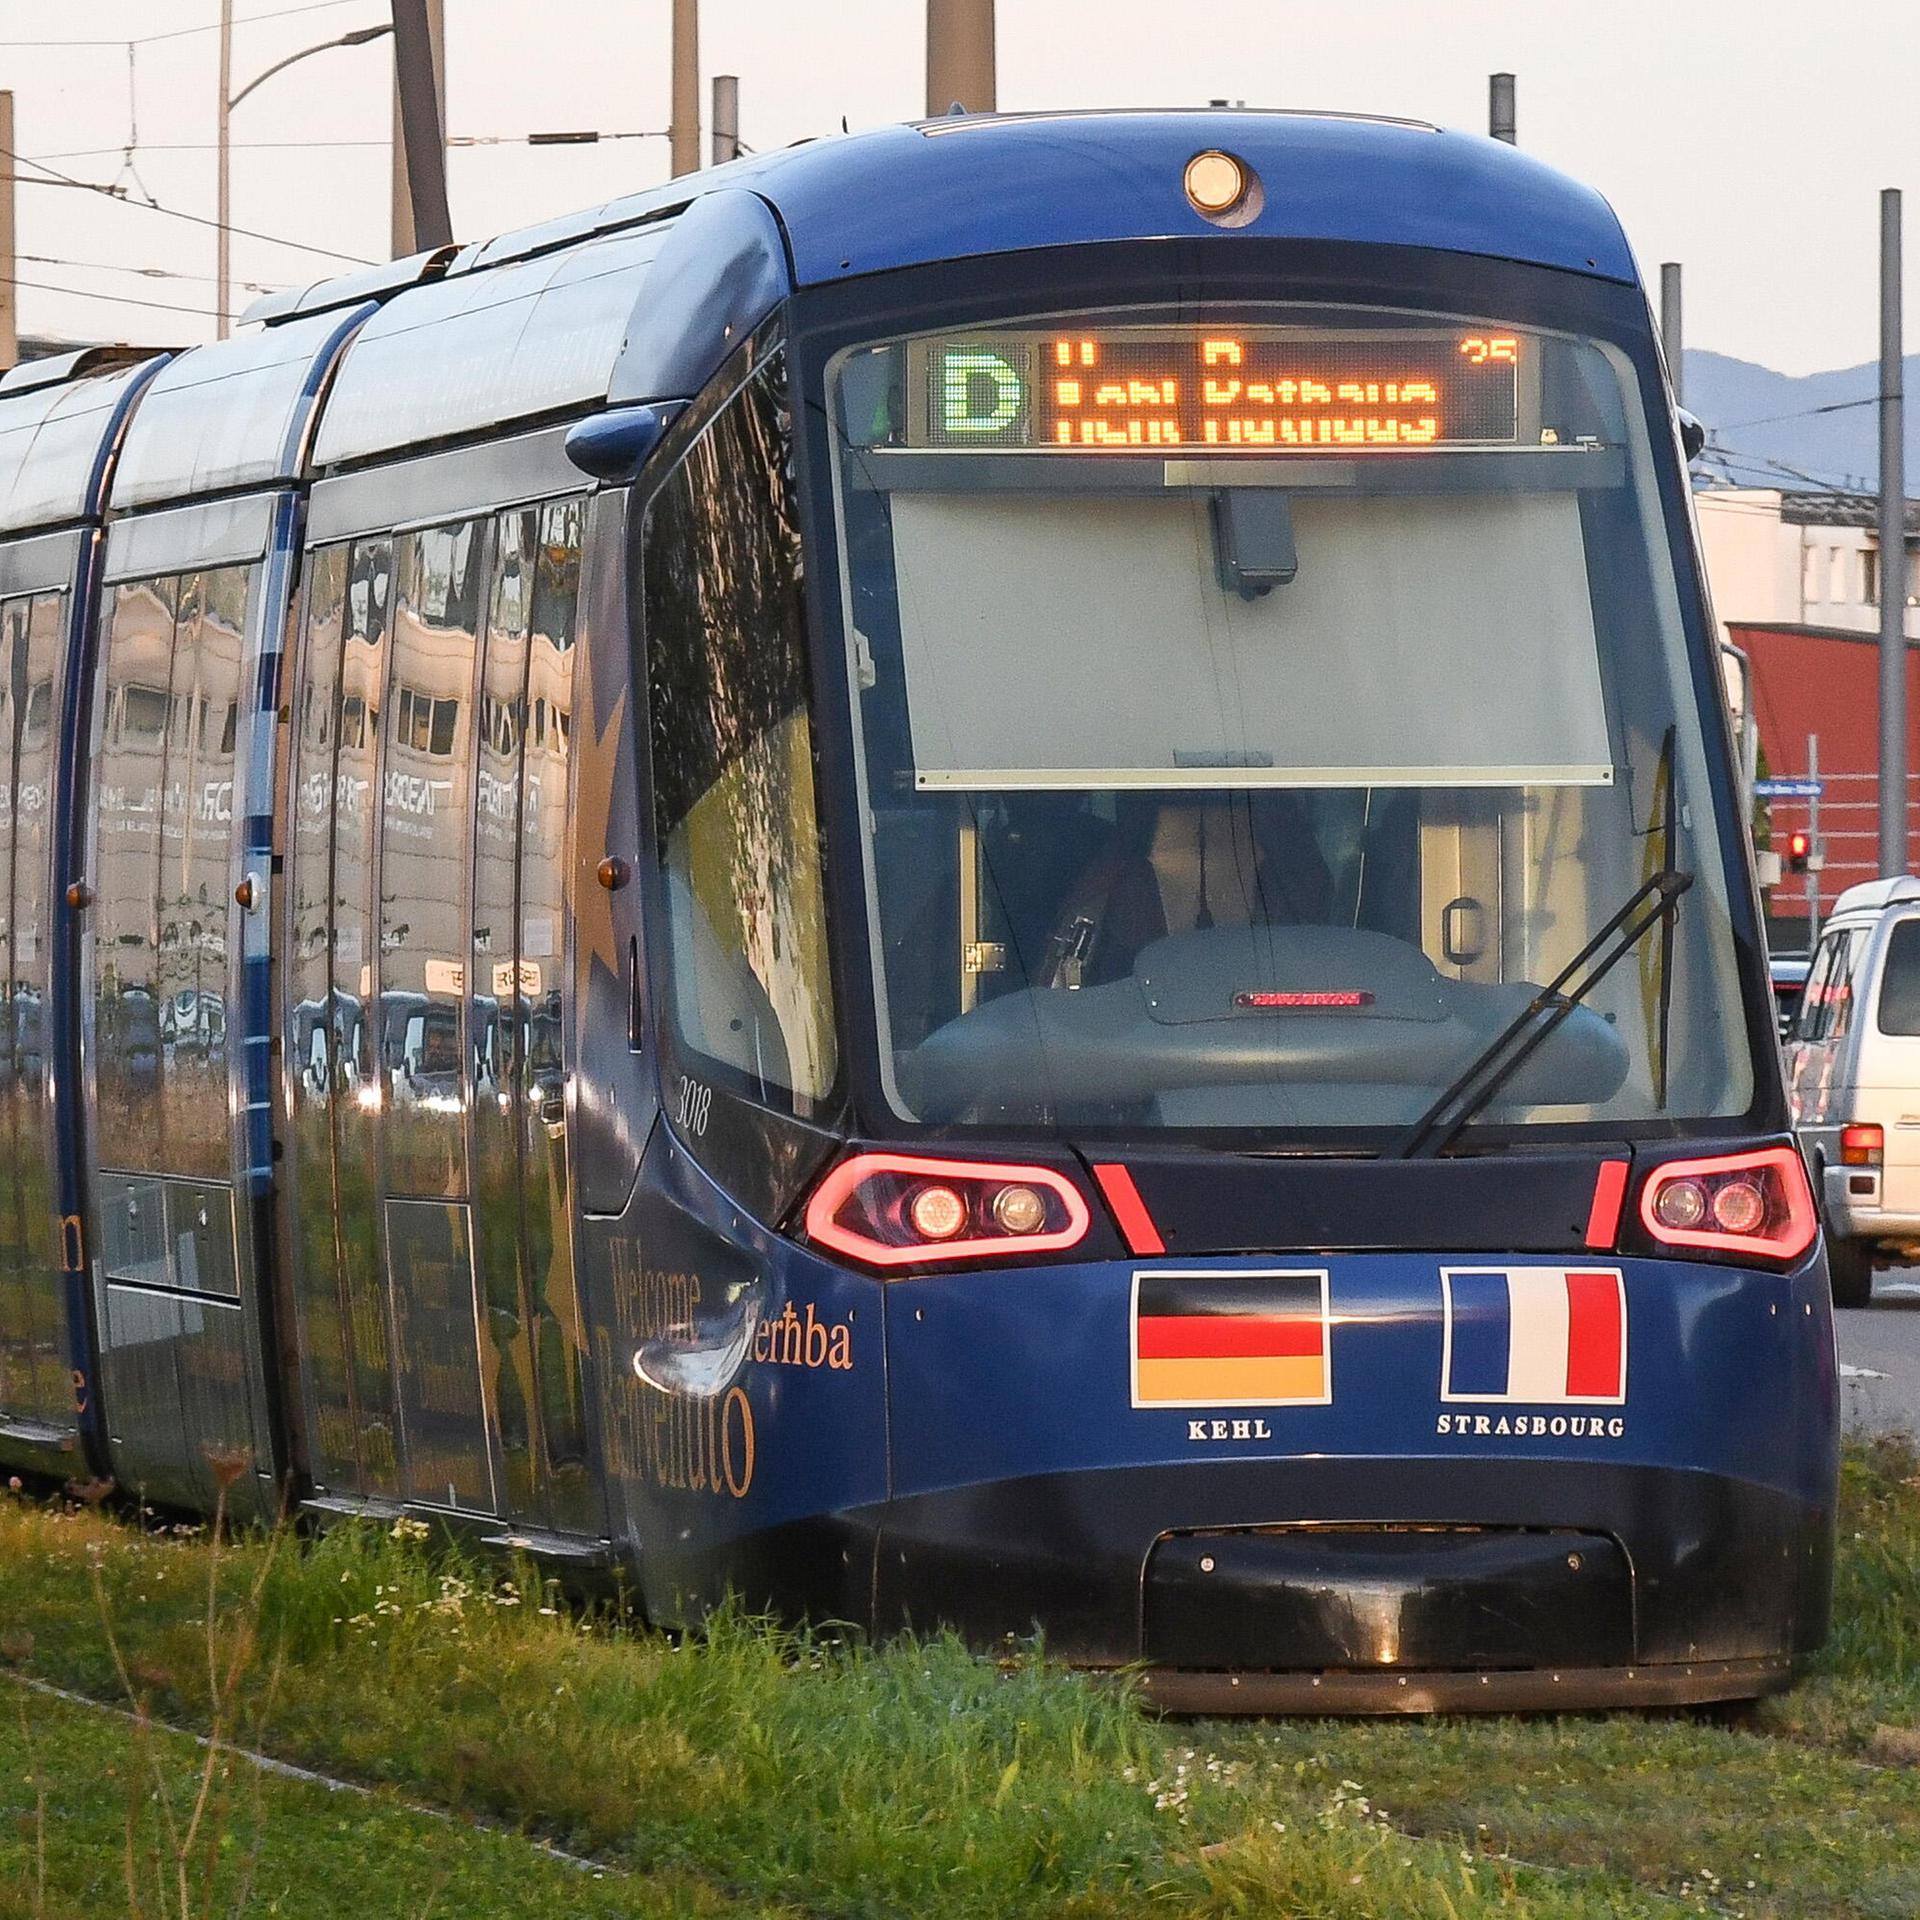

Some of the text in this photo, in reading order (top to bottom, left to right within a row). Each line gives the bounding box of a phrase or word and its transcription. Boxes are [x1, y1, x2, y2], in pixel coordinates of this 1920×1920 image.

[944, 353, 1021, 431] D
[676, 1075, 711, 1136] 3018
[1188, 1419, 1272, 1440] KEHL
[1436, 1414, 1625, 1437] STRASBOURG
